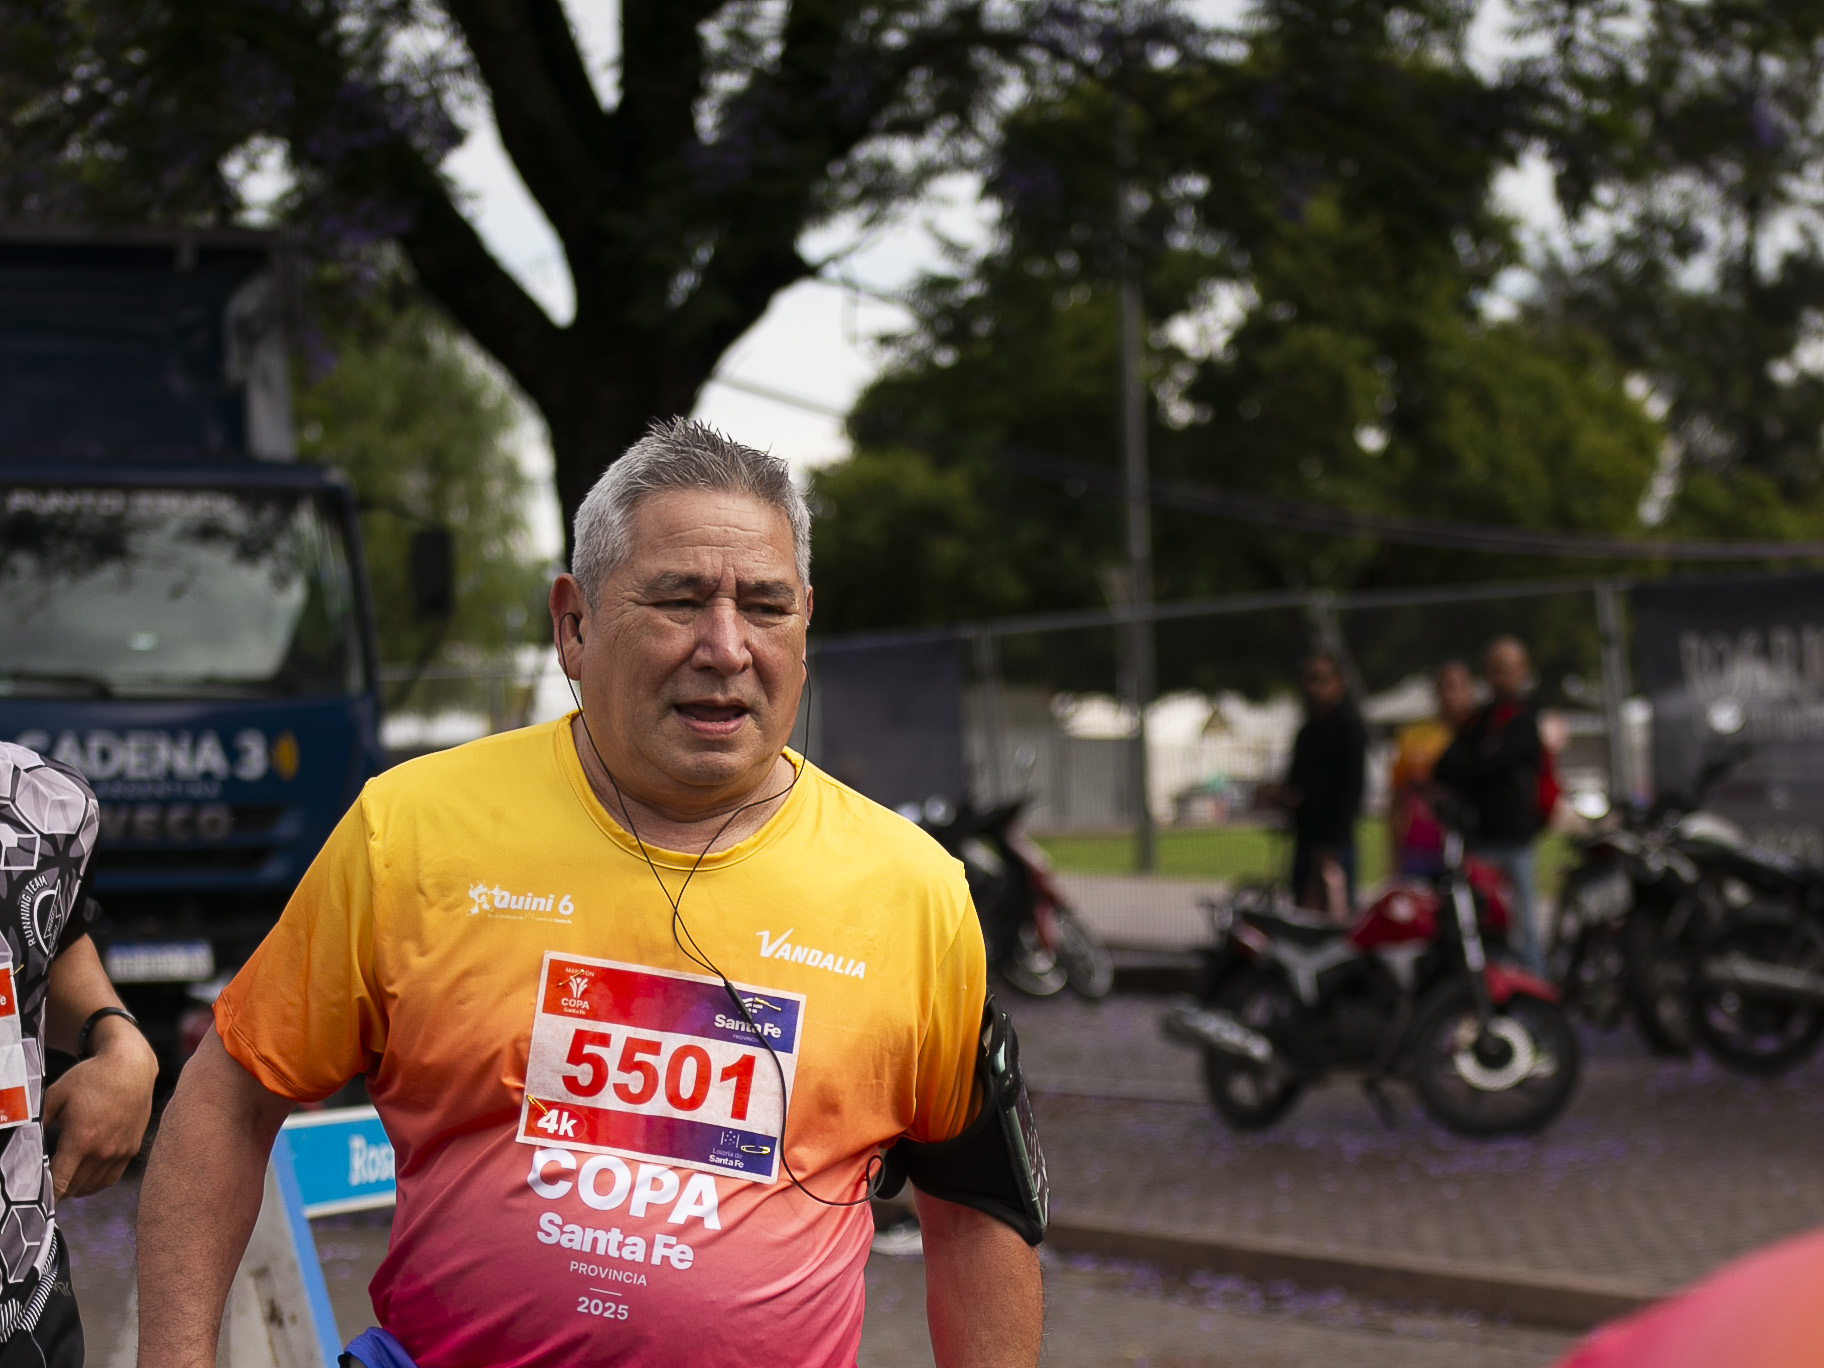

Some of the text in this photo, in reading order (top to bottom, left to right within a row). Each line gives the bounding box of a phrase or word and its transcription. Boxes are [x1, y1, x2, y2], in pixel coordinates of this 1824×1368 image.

[231, 727, 270, 782] 3
[98, 802, 234, 842] VECO
[20, 875, 49, 948] RUNNING TEAM
[493, 890, 575, 916] Quini 6
[755, 928, 867, 980] VANDALIA
[561, 997, 590, 1010] COPA
[732, 1033, 760, 1043] PROVINCI
[763, 1022, 782, 1039] Fe
[561, 1028, 757, 1122] 5501
[536, 1108, 578, 1138] 4k
[708, 1154, 745, 1168] Santa Fe
[526, 1147, 722, 1231] COPA
[536, 1211, 695, 1270] Santa Fe
[569, 1260, 648, 1287] PROVINCIA
[576, 1296, 630, 1321] 2025
